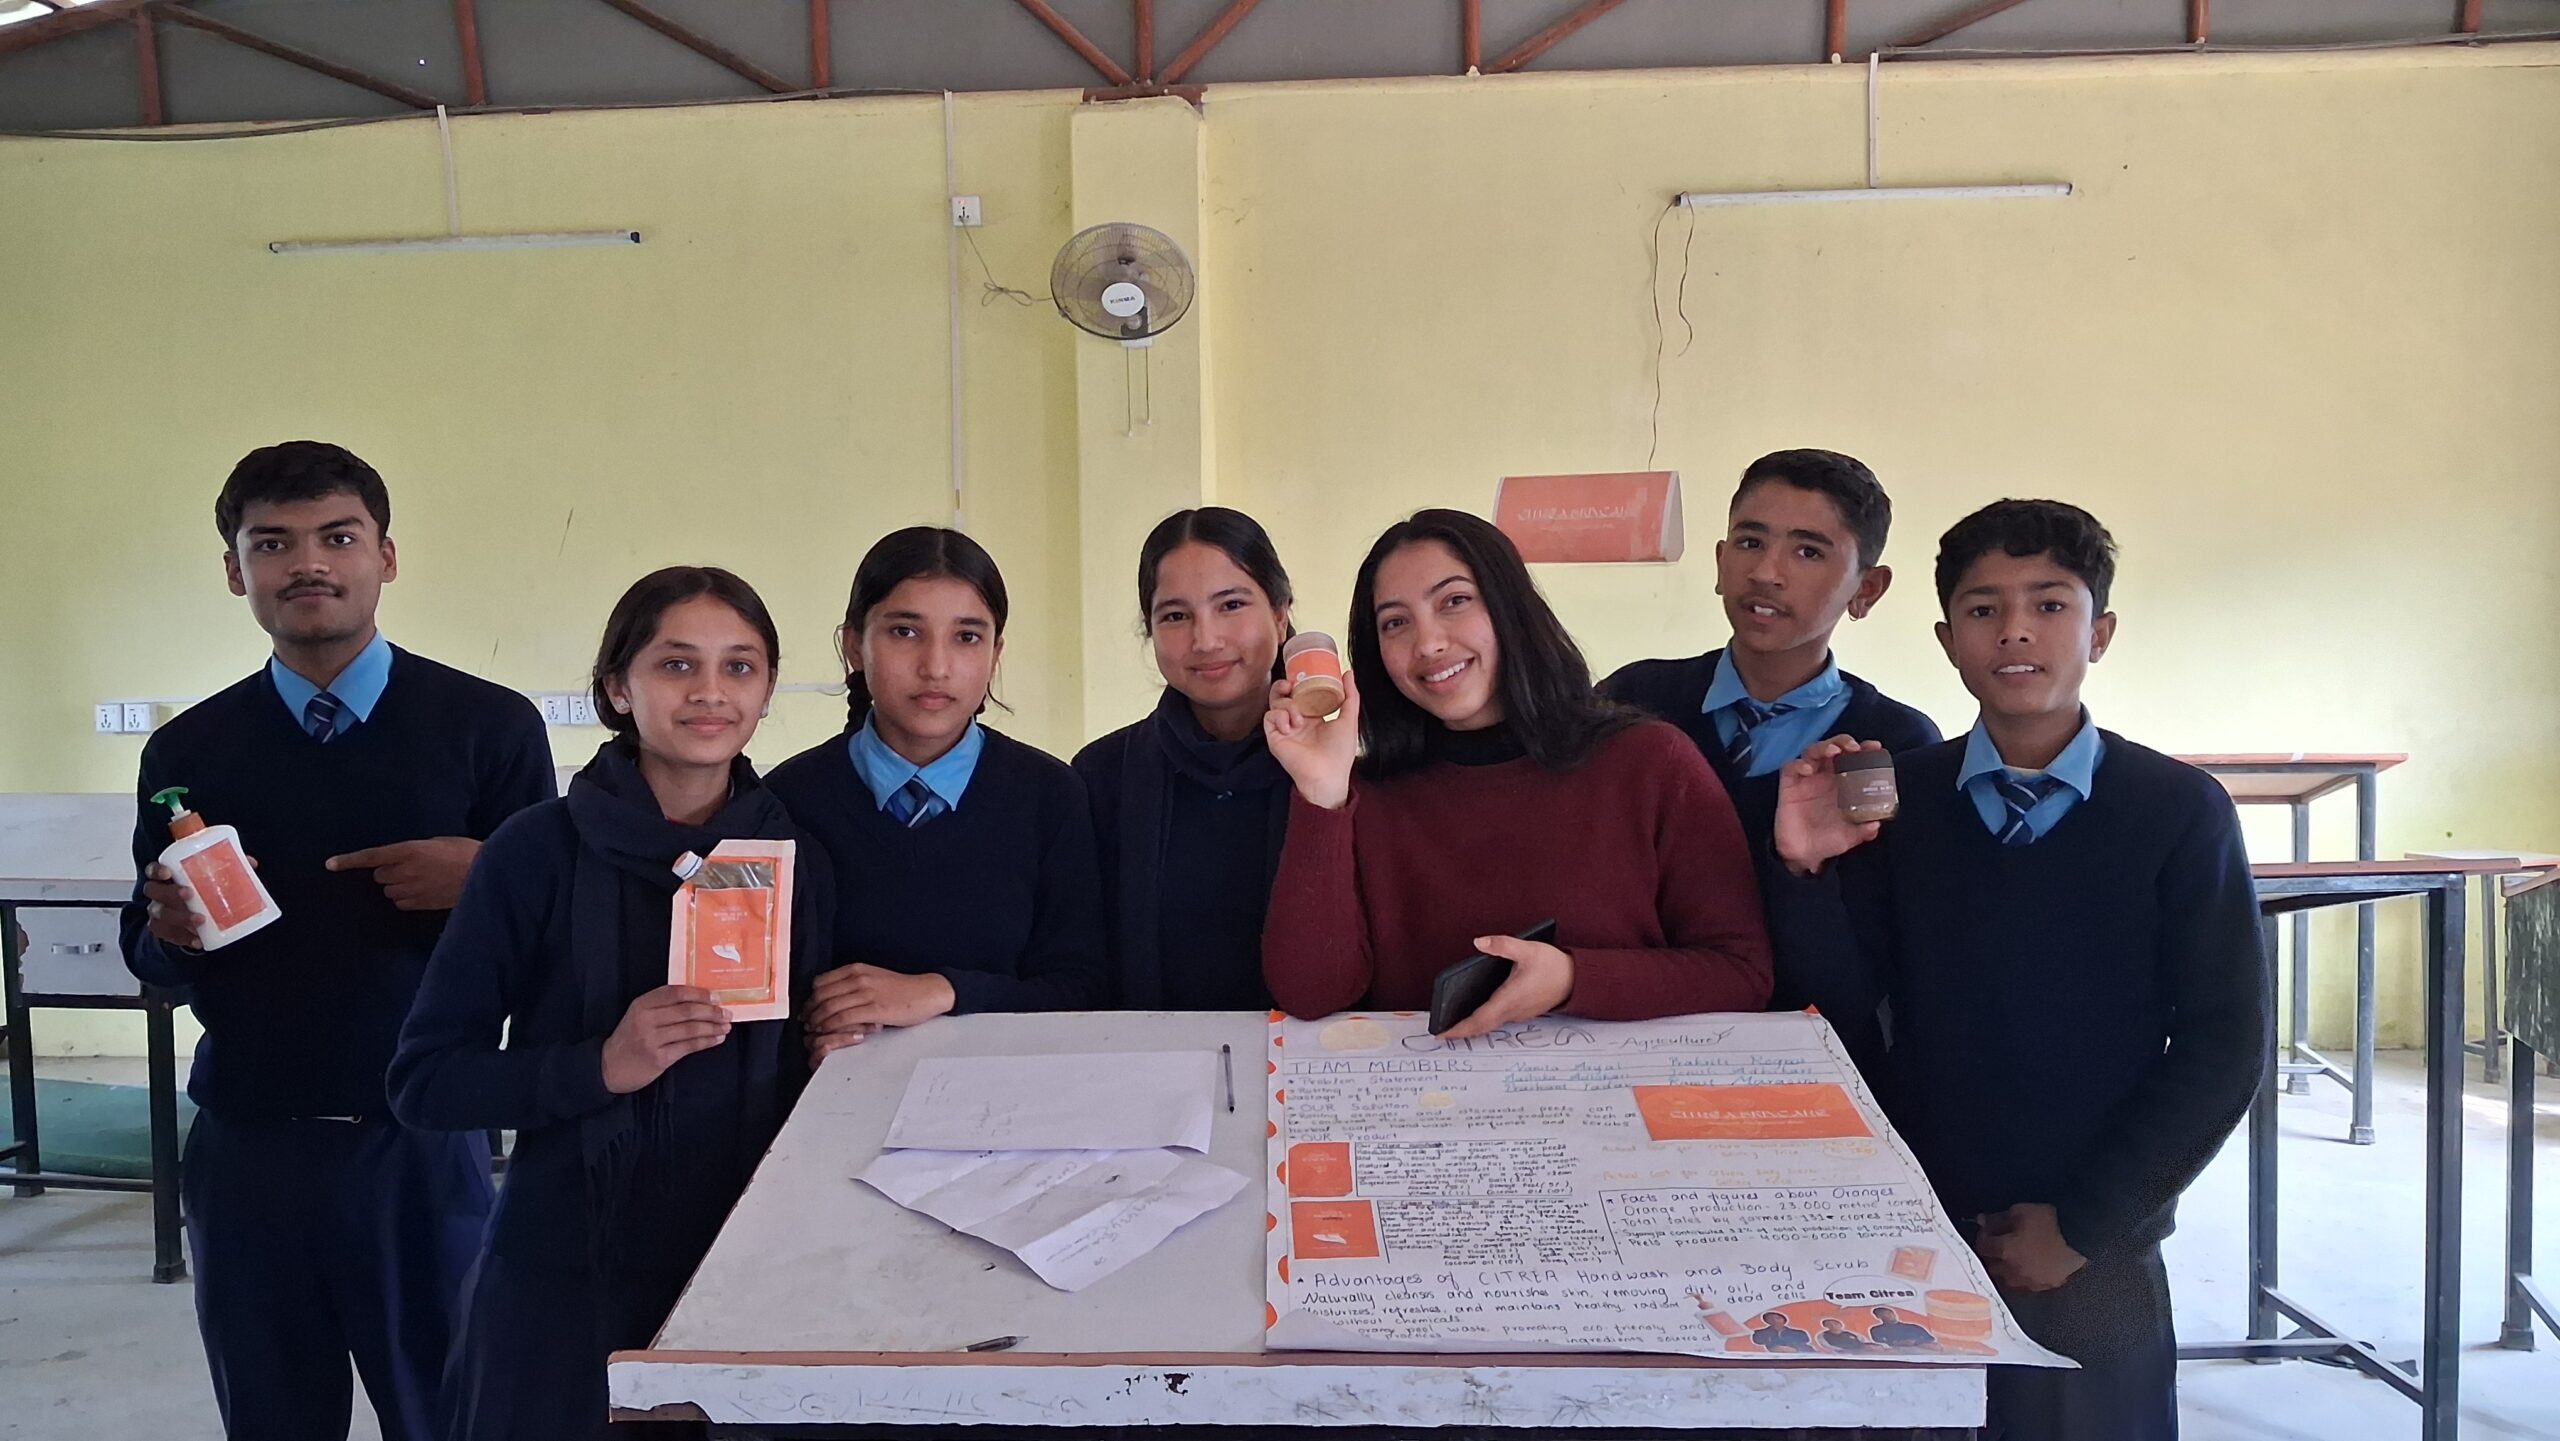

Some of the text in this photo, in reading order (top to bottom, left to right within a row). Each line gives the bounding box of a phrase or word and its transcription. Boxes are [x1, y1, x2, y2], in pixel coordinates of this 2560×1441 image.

[1290, 1060, 1351, 1075] TEAM
[1369, 1059, 1473, 1074] MEMBERS
[1300, 1103, 1336, 1112] OUR
[1588, 1105, 1613, 1113] can
[1300, 1132, 1333, 1141] OUR
[1621, 1192, 1658, 1204] Facts
[1671, 1191, 1699, 1202] and
[1774, 1187, 1819, 1200] about
[1624, 1204, 1676, 1219] Orange
[1621, 1216, 1657, 1228] Total
[1674, 1234, 1740, 1247] produced
[1314, 1272, 1423, 1296] Advantages
[1436, 1270, 1460, 1291] of
[1478, 1269, 1560, 1287] CITREA
[1684, 1265, 1723, 1280] and
[1740, 1261, 1793, 1282] Body
[1811, 1258, 1870, 1272] Scrub
[1301, 1290, 1377, 1310] Naturally
[1446, 1287, 1475, 1300] and
[1600, 1286, 1669, 1304] removing
[1770, 1279, 1806, 1293] and
[1727, 1292, 1764, 1304] dead
[1825, 1289, 1916, 1301] Team Citrea
[1454, 1303, 1484, 1314] and
[1678, 1323, 1707, 1332] and
